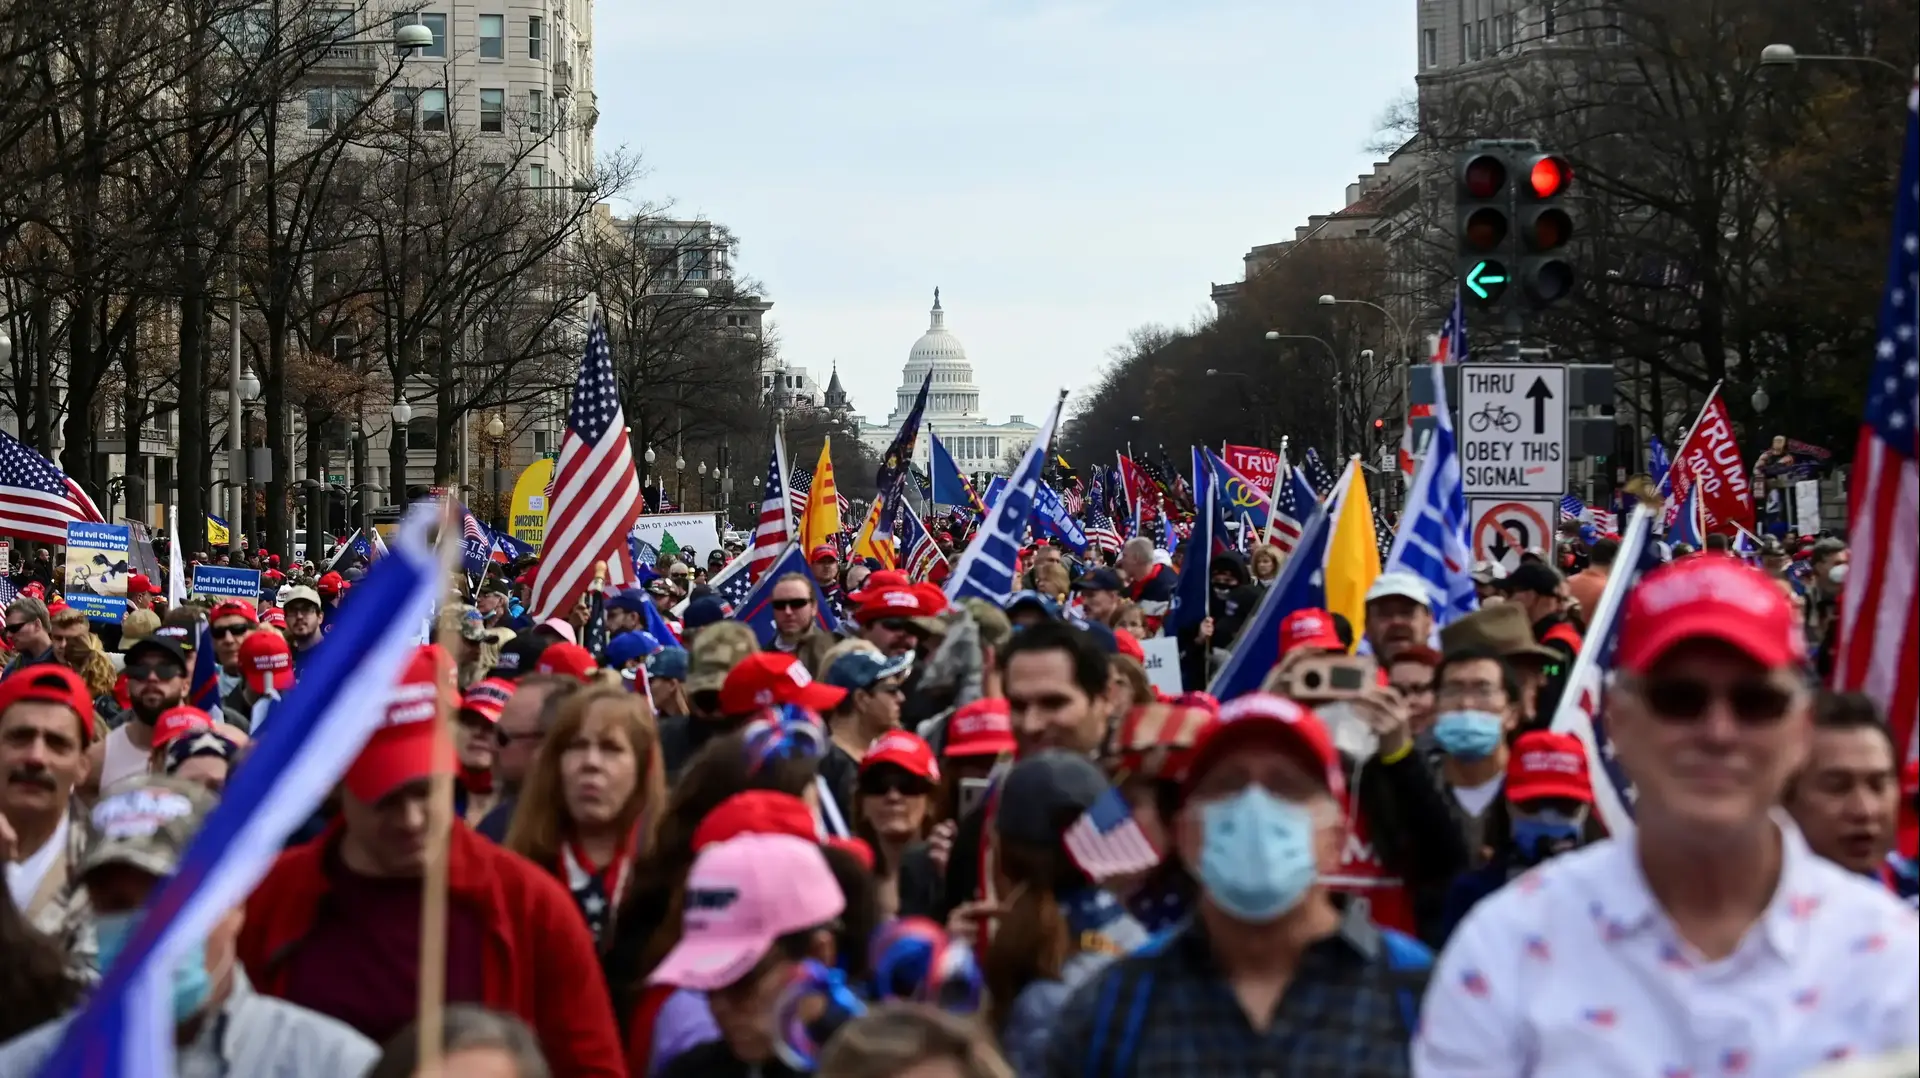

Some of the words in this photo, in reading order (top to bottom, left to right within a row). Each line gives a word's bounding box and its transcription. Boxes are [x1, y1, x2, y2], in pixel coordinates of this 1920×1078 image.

[1466, 373, 1515, 394] THRU
[1465, 441, 1514, 461] OBEY
[1520, 441, 1561, 462] THIS
[1465, 466, 1530, 486] SIGNAL
[70, 530, 84, 538] End
[98, 532, 127, 542] Chinese
[67, 538, 109, 549] Communist
[109, 542, 129, 551] Party
[465, 550, 482, 561] FOR
[196, 575, 211, 583] End
[211, 576, 225, 584] Evil
[226, 578, 256, 587] Chinese
[193, 584, 236, 594] Communist
[237, 587, 258, 597] Party
[103, 597, 126, 606] AMERICA
